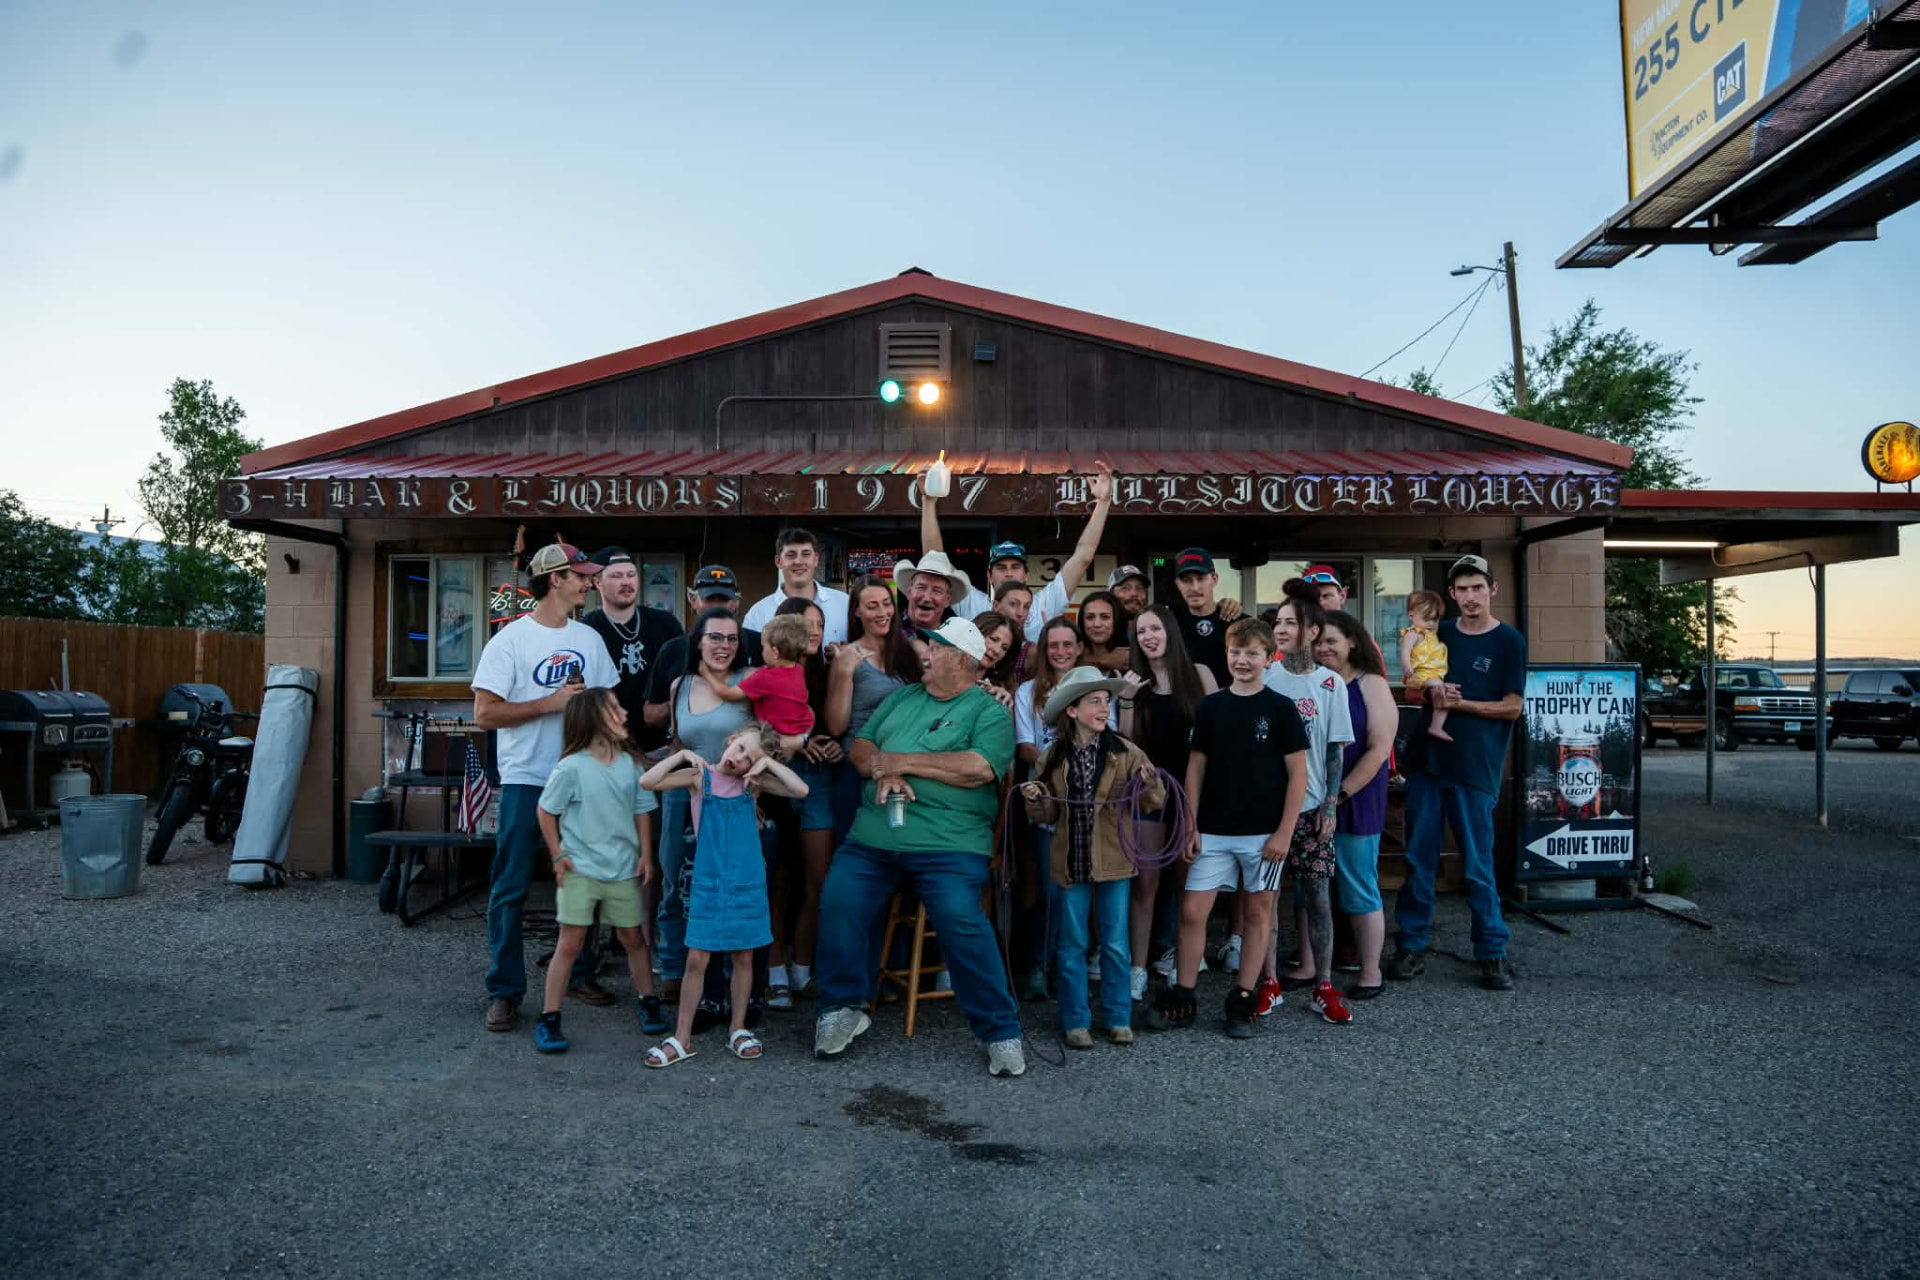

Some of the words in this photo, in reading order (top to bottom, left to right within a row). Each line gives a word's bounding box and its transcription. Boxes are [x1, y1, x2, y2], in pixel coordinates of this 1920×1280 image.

[1634, 20, 1680, 102] 255
[1690, 0, 1745, 43] CT
[1716, 60, 1743, 106] CAT
[225, 482, 307, 515] 3-H
[329, 481, 422, 508] BAR
[449, 480, 477, 515] &
[502, 479, 739, 514] LIQUORS
[1406, 475, 1620, 513] LOUNGE
[711, 570, 726, 579] T
[546, 660, 579, 685] Lite
[1547, 682, 1581, 695] HUNT
[1588, 682, 1613, 695] THE
[1526, 697, 1592, 715] TROPHY
[1597, 697, 1634, 715] CAN
[1558, 772, 1601, 786] BUSCH
[1565, 787, 1593, 796] LIGHT
[1546, 836, 1588, 856] DRIVE
[1591, 835, 1630, 855] THRU
